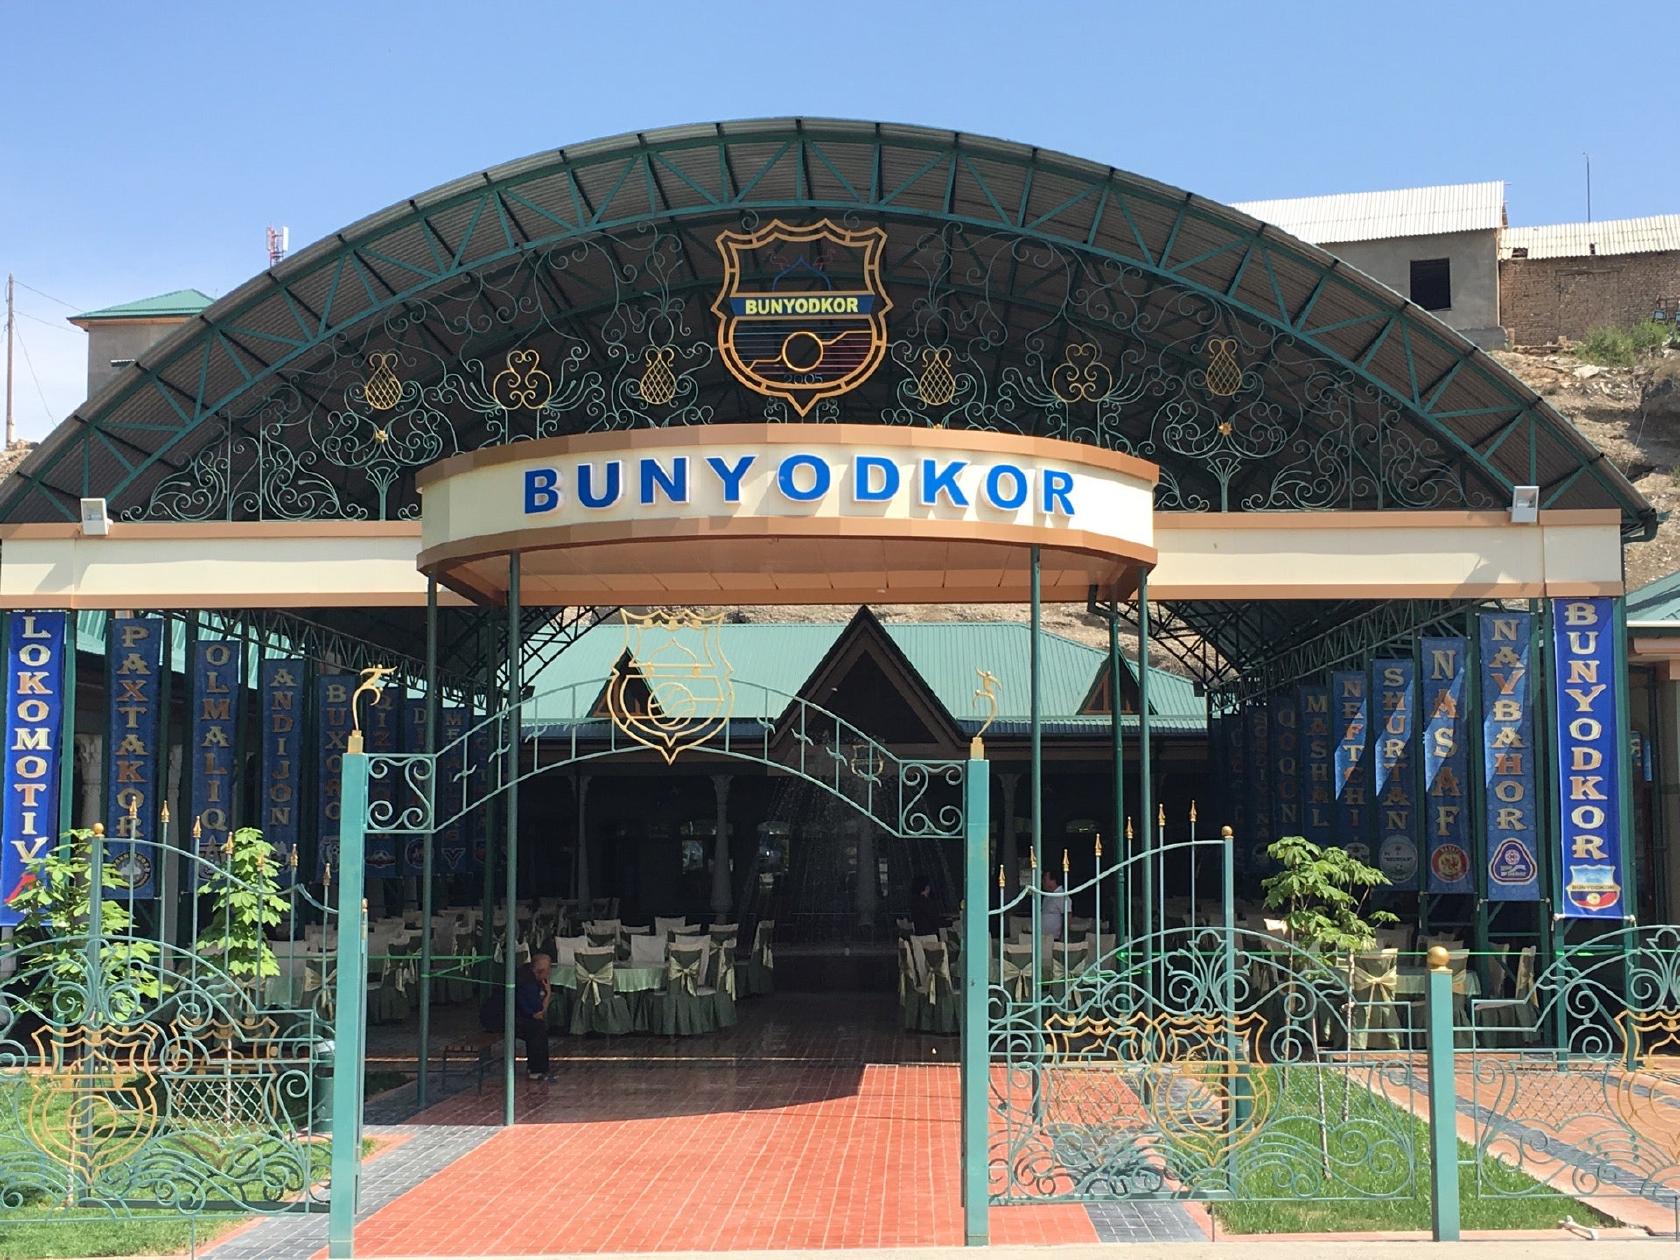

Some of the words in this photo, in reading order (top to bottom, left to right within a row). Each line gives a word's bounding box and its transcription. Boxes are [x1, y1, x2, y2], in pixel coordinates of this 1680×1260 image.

[744, 297, 859, 315] BUNYODKOR
[523, 454, 1077, 518] BUNYODKOR
[11, 616, 53, 863] LOKOMOTIV
[115, 625, 151, 838] PAXTAKOR
[201, 645, 231, 832] OLMALIQ
[269, 668, 298, 826] ANDIJON
[1306, 695, 1329, 827] MASHAL
[1343, 681, 1365, 827] NEFTCHI
[1381, 667, 1409, 830] SHURTAN
[1431, 650, 1461, 836] NASAF
[1490, 619, 1527, 831] NAVBAHOR
[1564, 602, 1608, 859] BUNYODKOR
